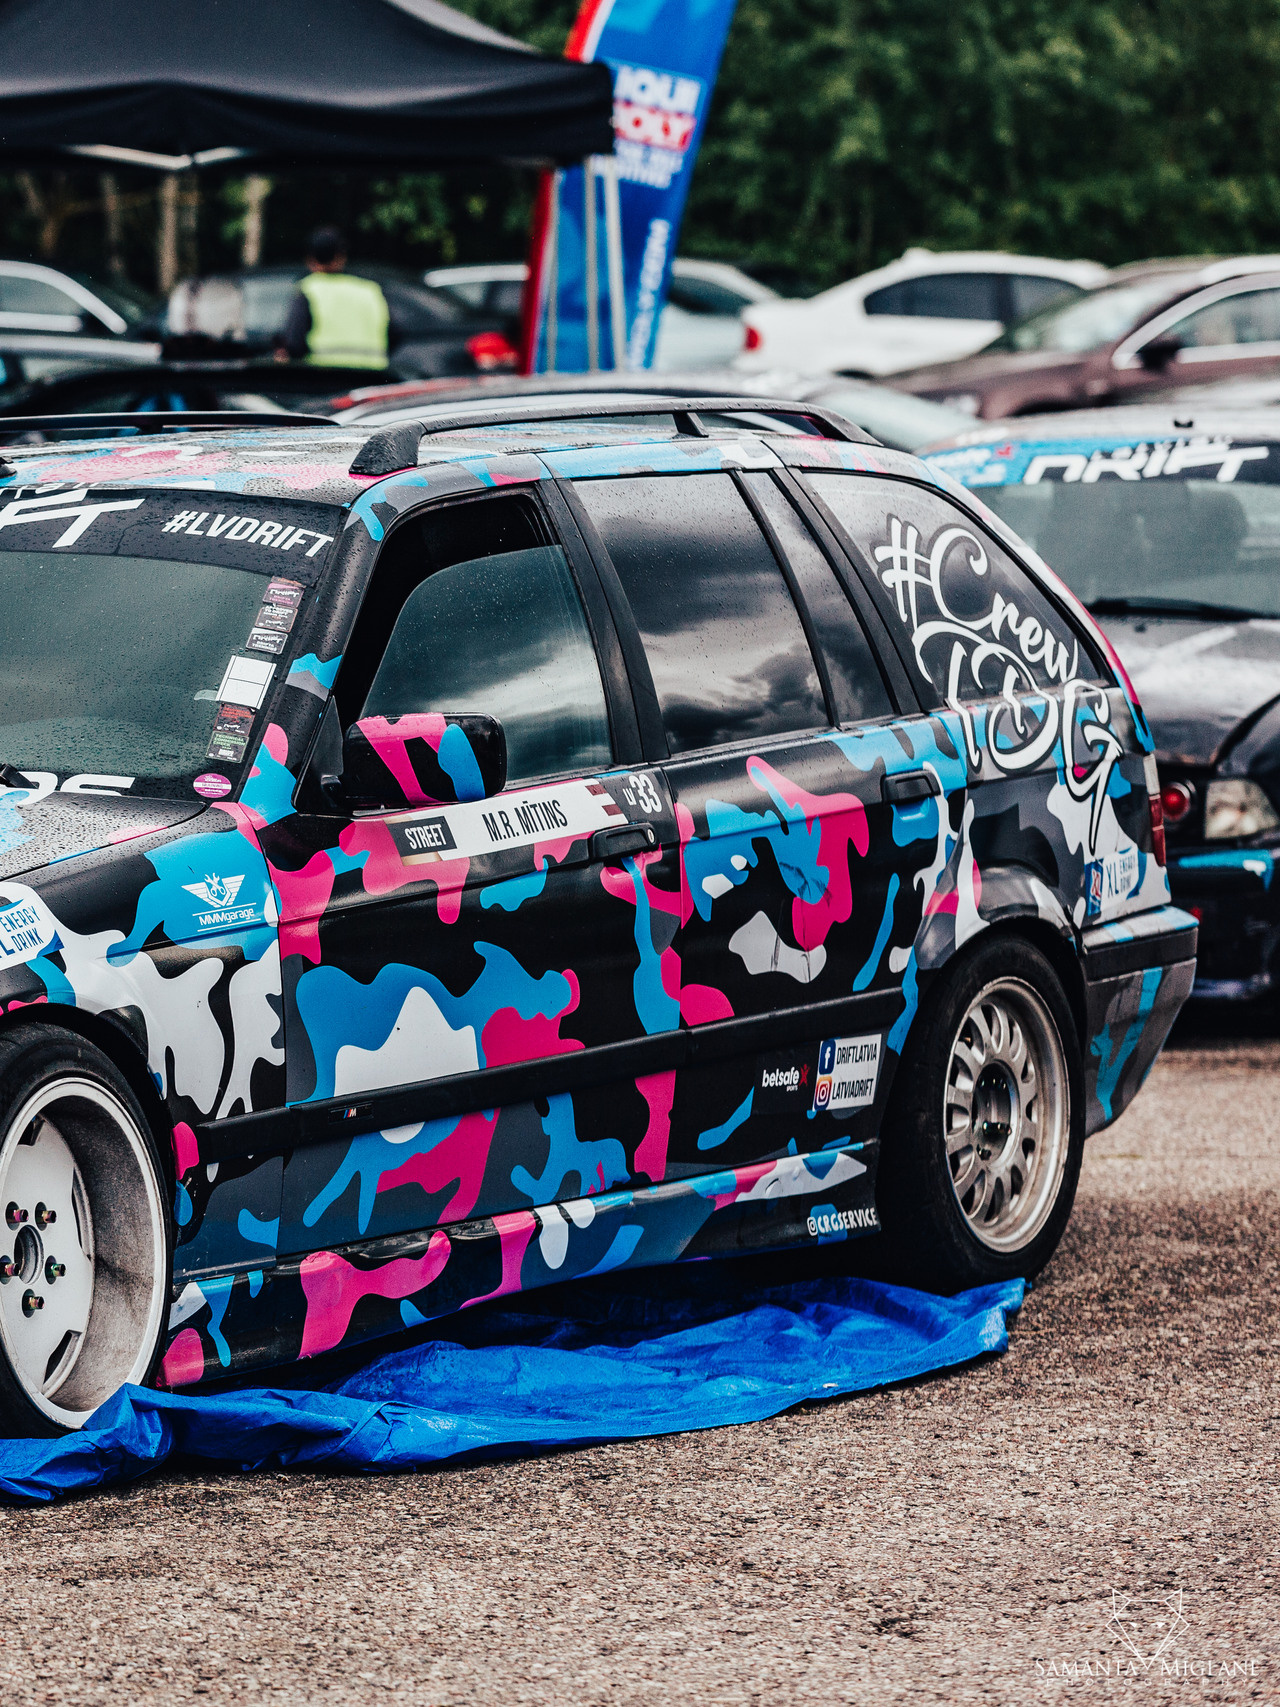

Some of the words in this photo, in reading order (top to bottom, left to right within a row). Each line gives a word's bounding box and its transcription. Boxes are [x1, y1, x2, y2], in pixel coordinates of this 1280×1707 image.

[161, 510, 334, 558] #LVDRIFT
[629, 773, 663, 814] 33
[481, 812, 520, 842] M.R.
[513, 799, 568, 837] MĪTINS
[404, 823, 447, 850] STREET
[1105, 861, 1119, 898] XL
[198, 908, 255, 926] MMMgarage
[10, 927, 45, 951] DRINK
[836, 1043, 877, 1065] DRIFTLATVIA
[762, 1066, 800, 1088] betsafe
[831, 1078, 874, 1100] LATVIADRIFT
